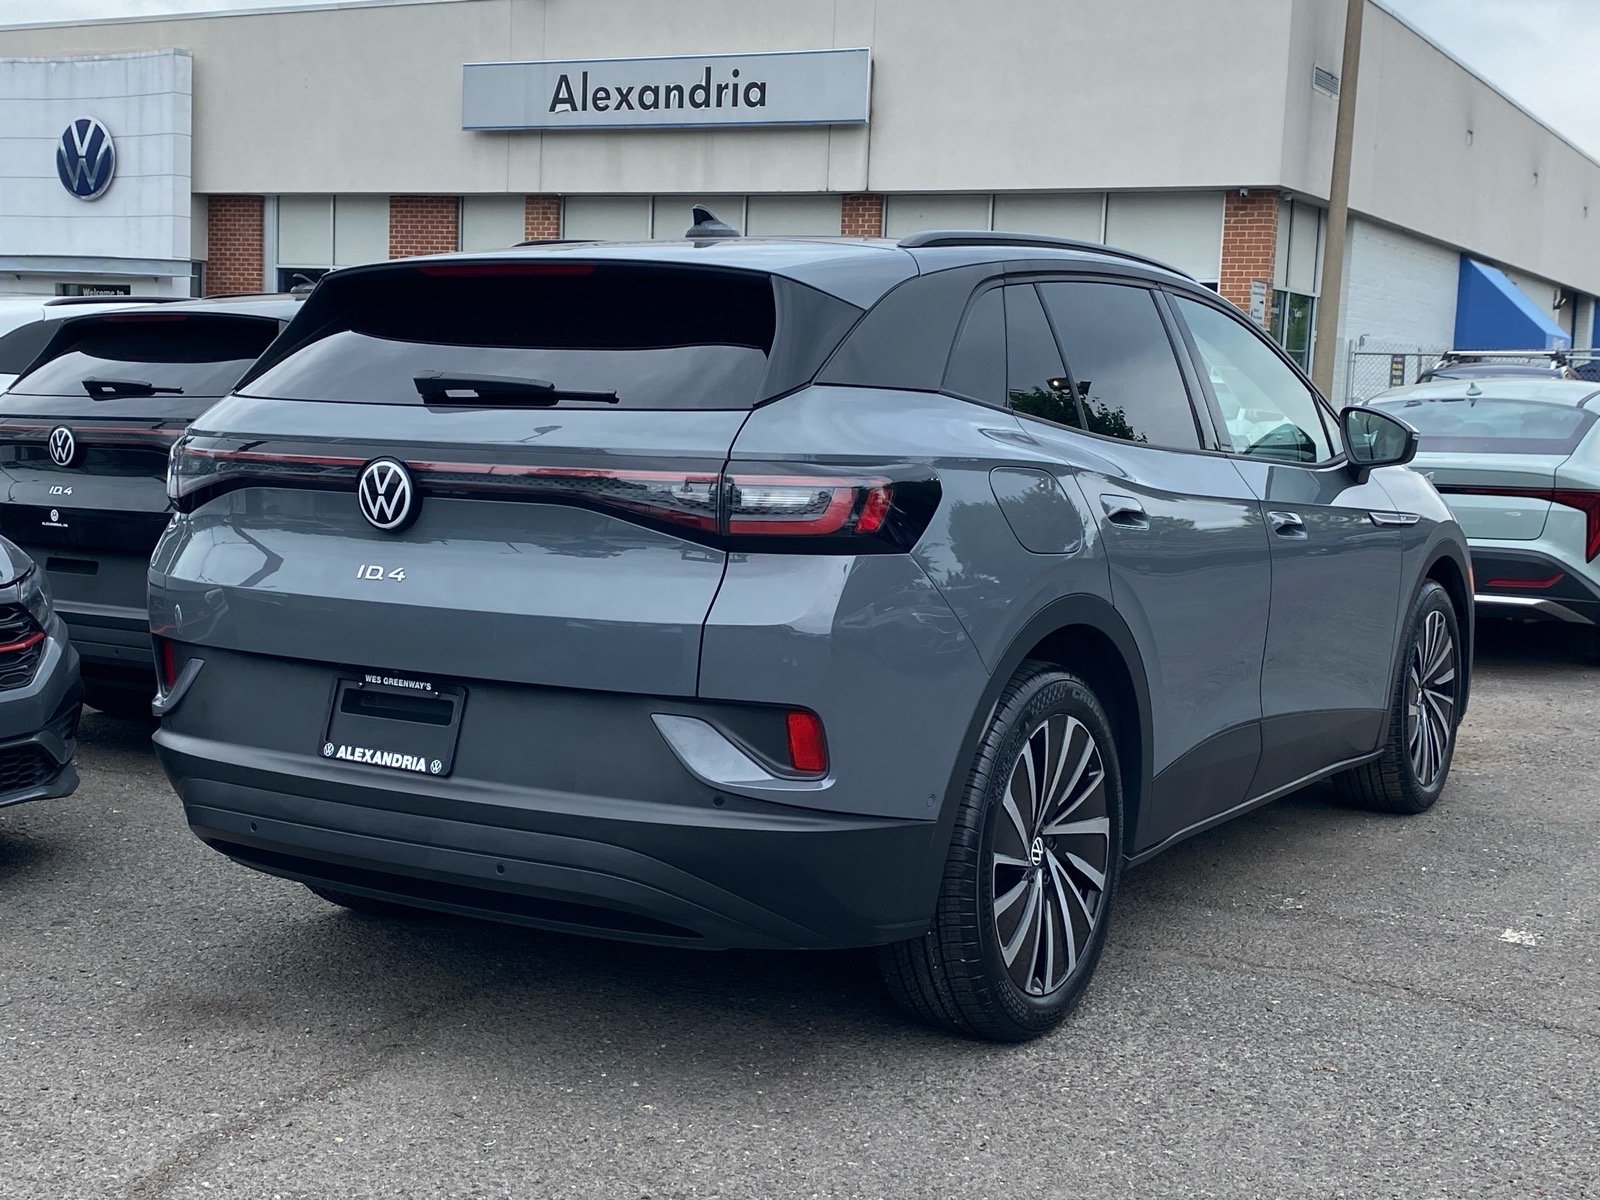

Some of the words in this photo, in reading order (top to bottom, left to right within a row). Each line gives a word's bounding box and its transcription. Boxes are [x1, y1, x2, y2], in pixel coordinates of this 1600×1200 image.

[549, 66, 767, 113] Alexandria
[57, 116, 115, 201] VW
[49, 428, 74, 466] VW
[359, 461, 411, 529] VW
[365, 674, 382, 684] WES
[383, 677, 432, 690] GREENWAY'S
[336, 745, 426, 771] ALEXANDRIA
